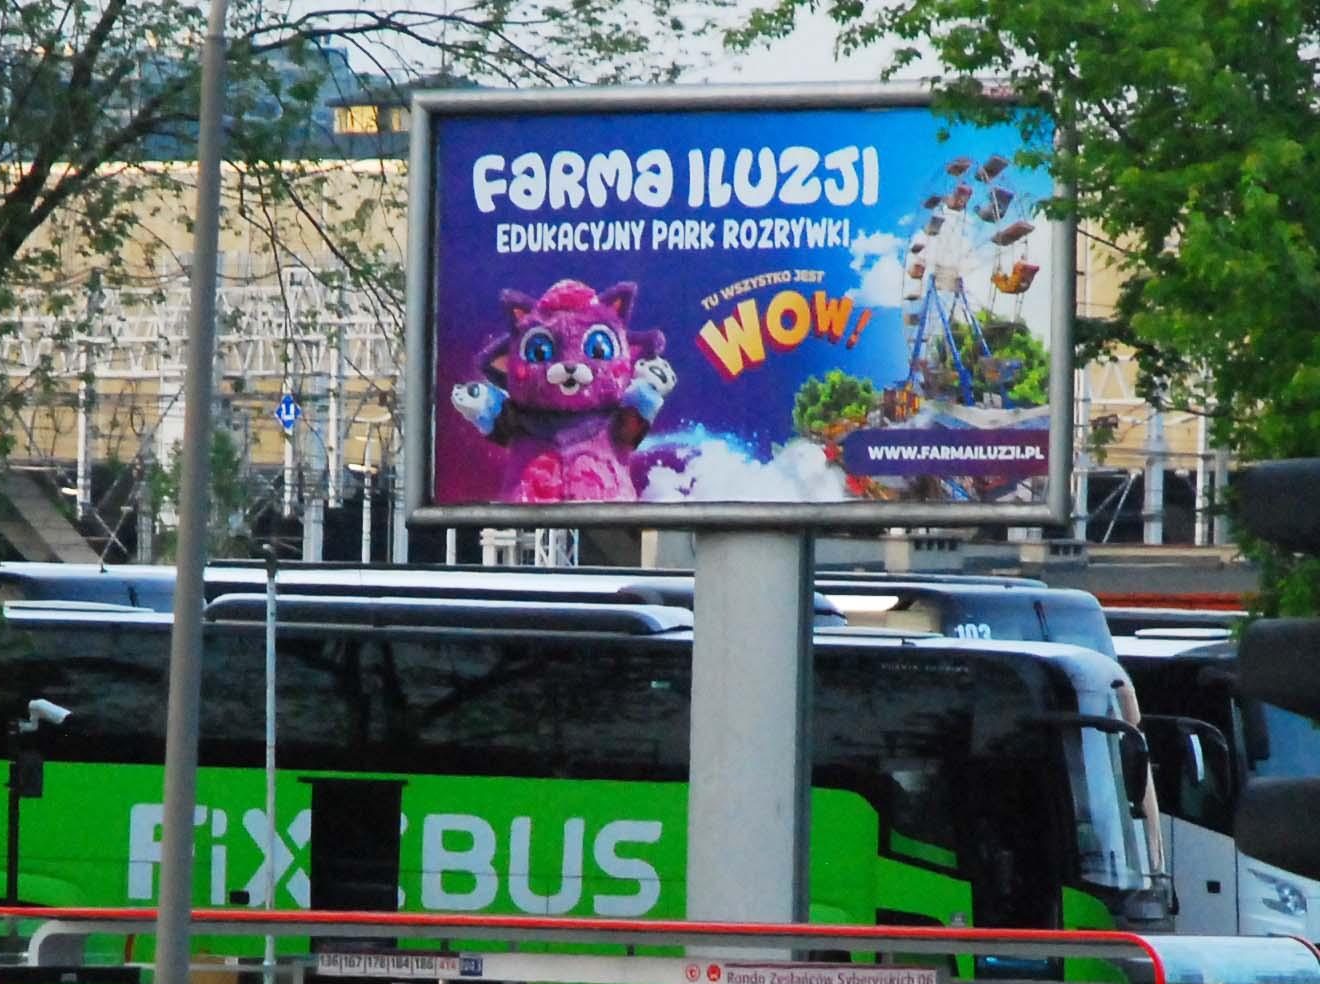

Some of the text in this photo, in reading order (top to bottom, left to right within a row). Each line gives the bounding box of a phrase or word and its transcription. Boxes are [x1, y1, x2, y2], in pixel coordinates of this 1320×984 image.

[688, 145, 880, 208] ILUZJI
[496, 216, 850, 253] EDUKACYJNY PARK ROZRYWKI
[700, 269, 826, 311] TU WSZYSTKO JEST
[697, 290, 872, 379] WOW!
[868, 445, 1045, 460] WWW.FARMAILUZJI.PL
[727, 970, 766, 984] Rondo
